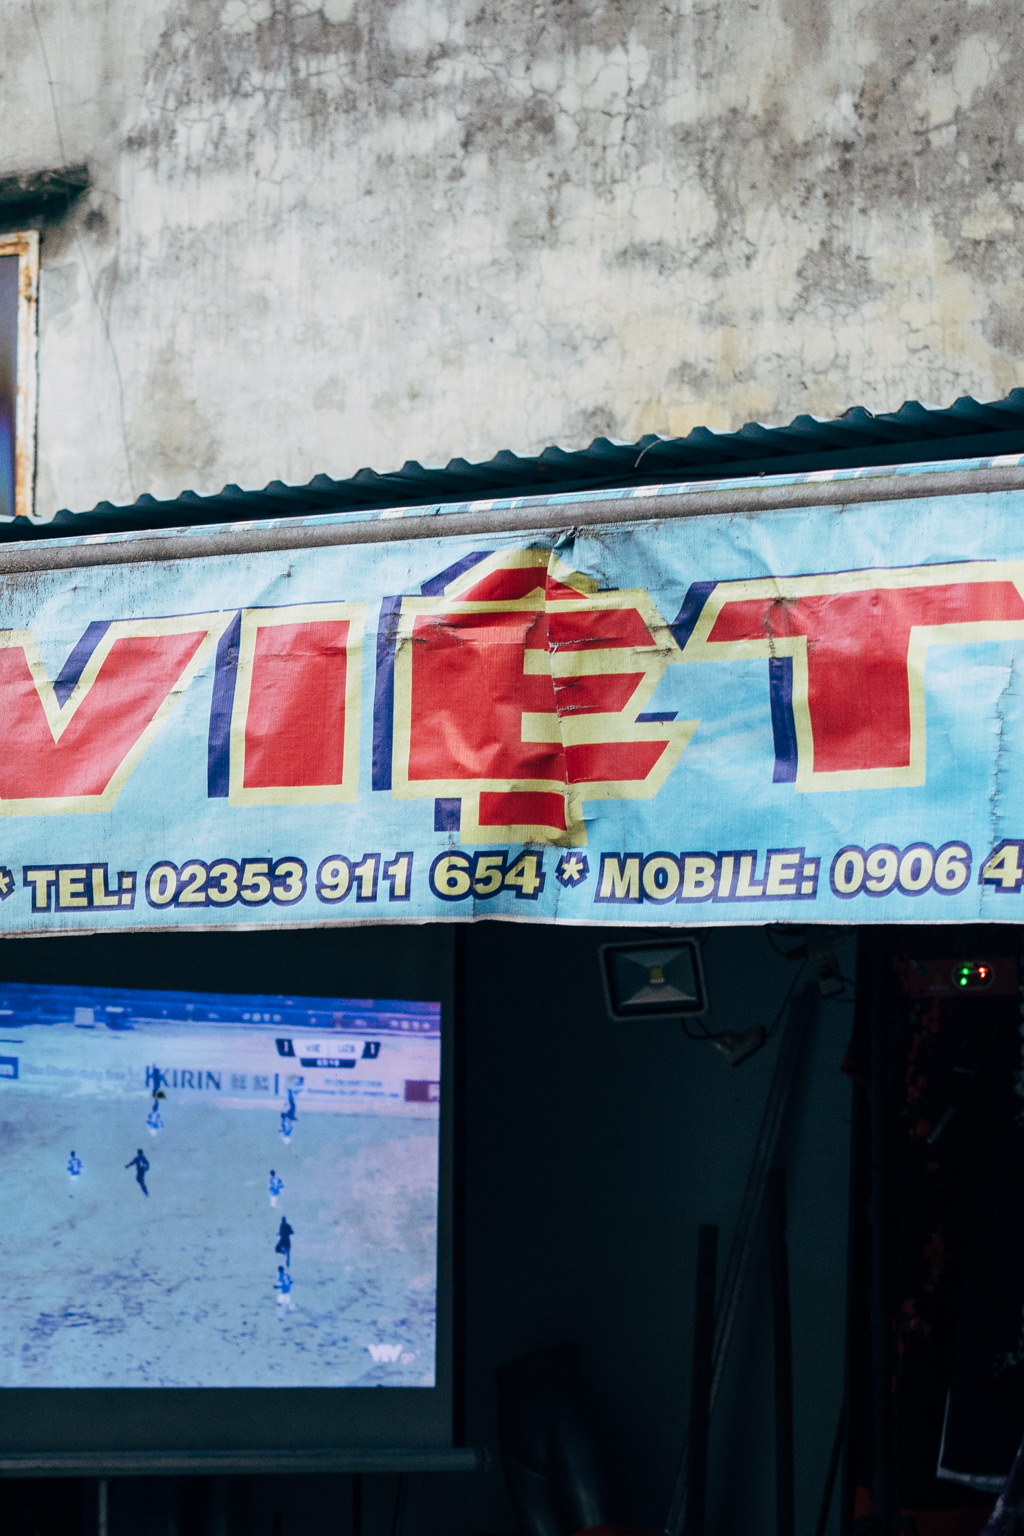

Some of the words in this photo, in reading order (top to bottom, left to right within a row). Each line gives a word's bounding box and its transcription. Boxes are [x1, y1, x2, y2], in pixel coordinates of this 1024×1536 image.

[23, 863, 137, 912] TEL:
[145, 857, 307, 909] 02353
[316, 852, 413, 904] 911
[429, 850, 545, 900] 654
[594, 848, 821, 904] MOBILE:
[830, 841, 972, 895] 0906
